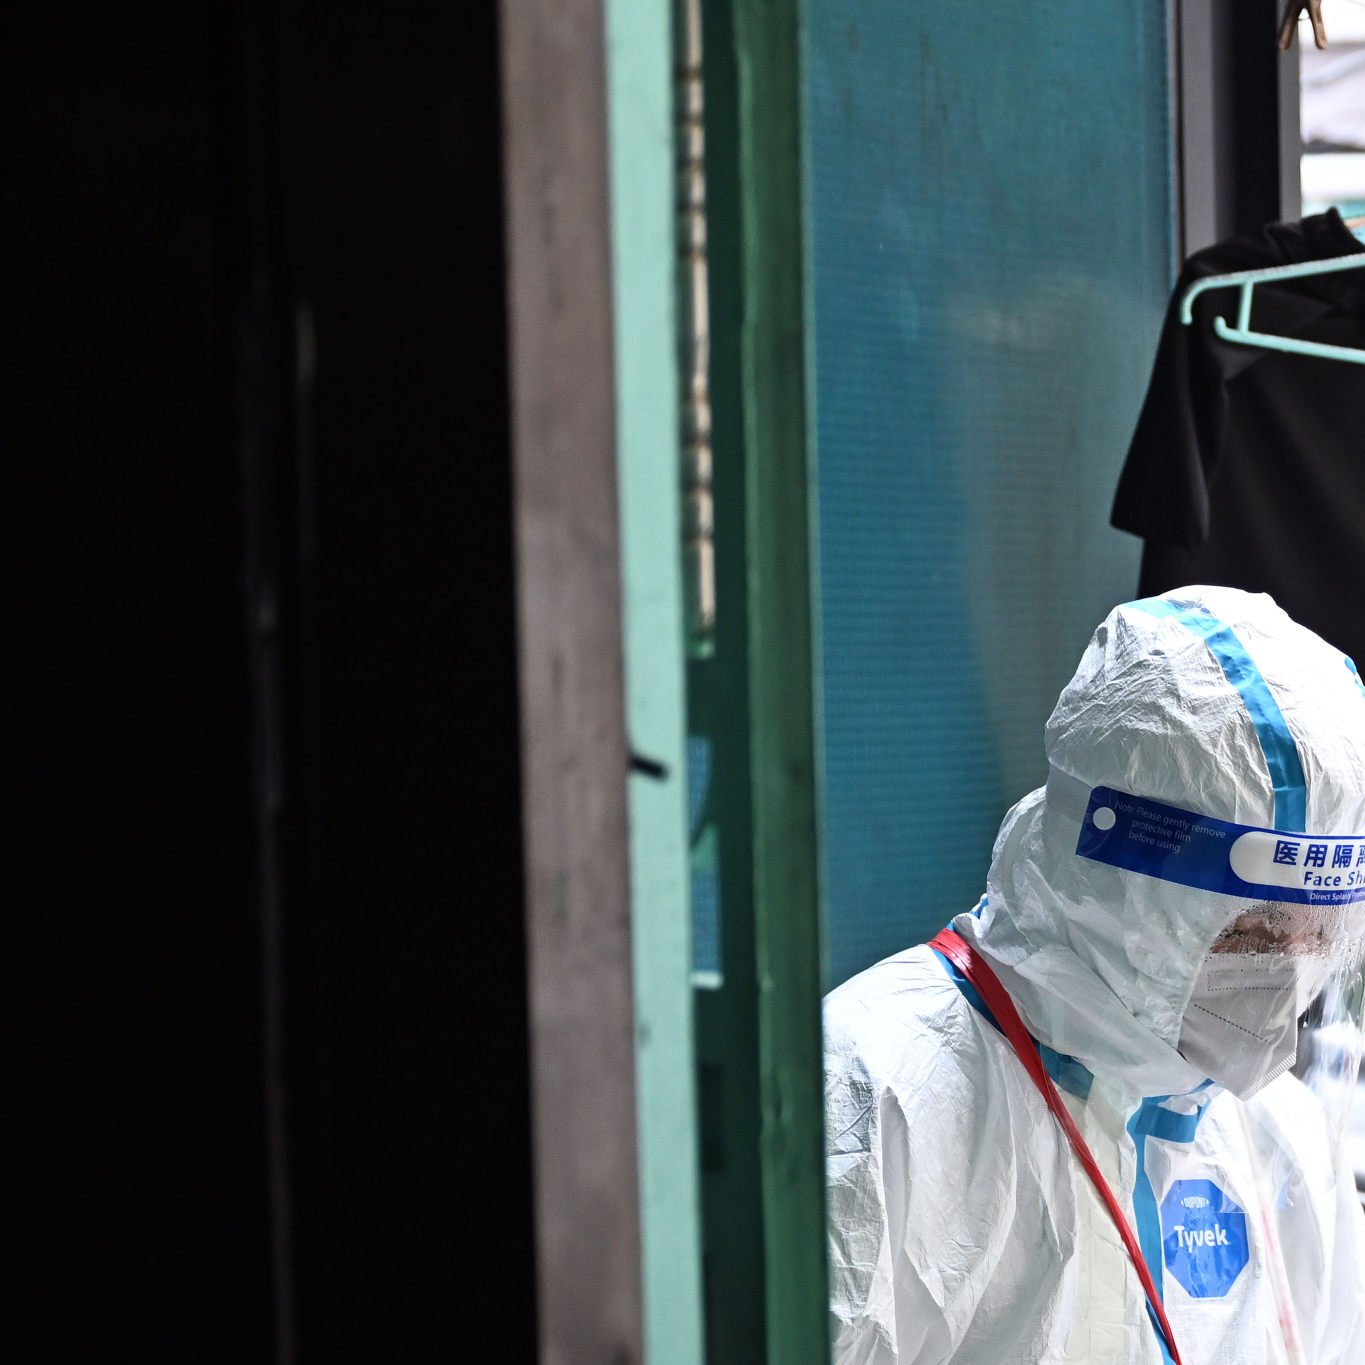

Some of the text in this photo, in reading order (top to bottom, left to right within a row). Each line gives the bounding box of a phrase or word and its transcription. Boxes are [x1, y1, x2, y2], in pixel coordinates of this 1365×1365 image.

[1131, 819, 1191, 843] protective film
[1163, 816, 1191, 830] gently
[1191, 824, 1226, 839] remove
[1128, 831, 1181, 855] before using
[1303, 871, 1342, 887] Face
[1310, 892, 1331, 901] Direct
[1173, 1223, 1230, 1254] Tyvek
